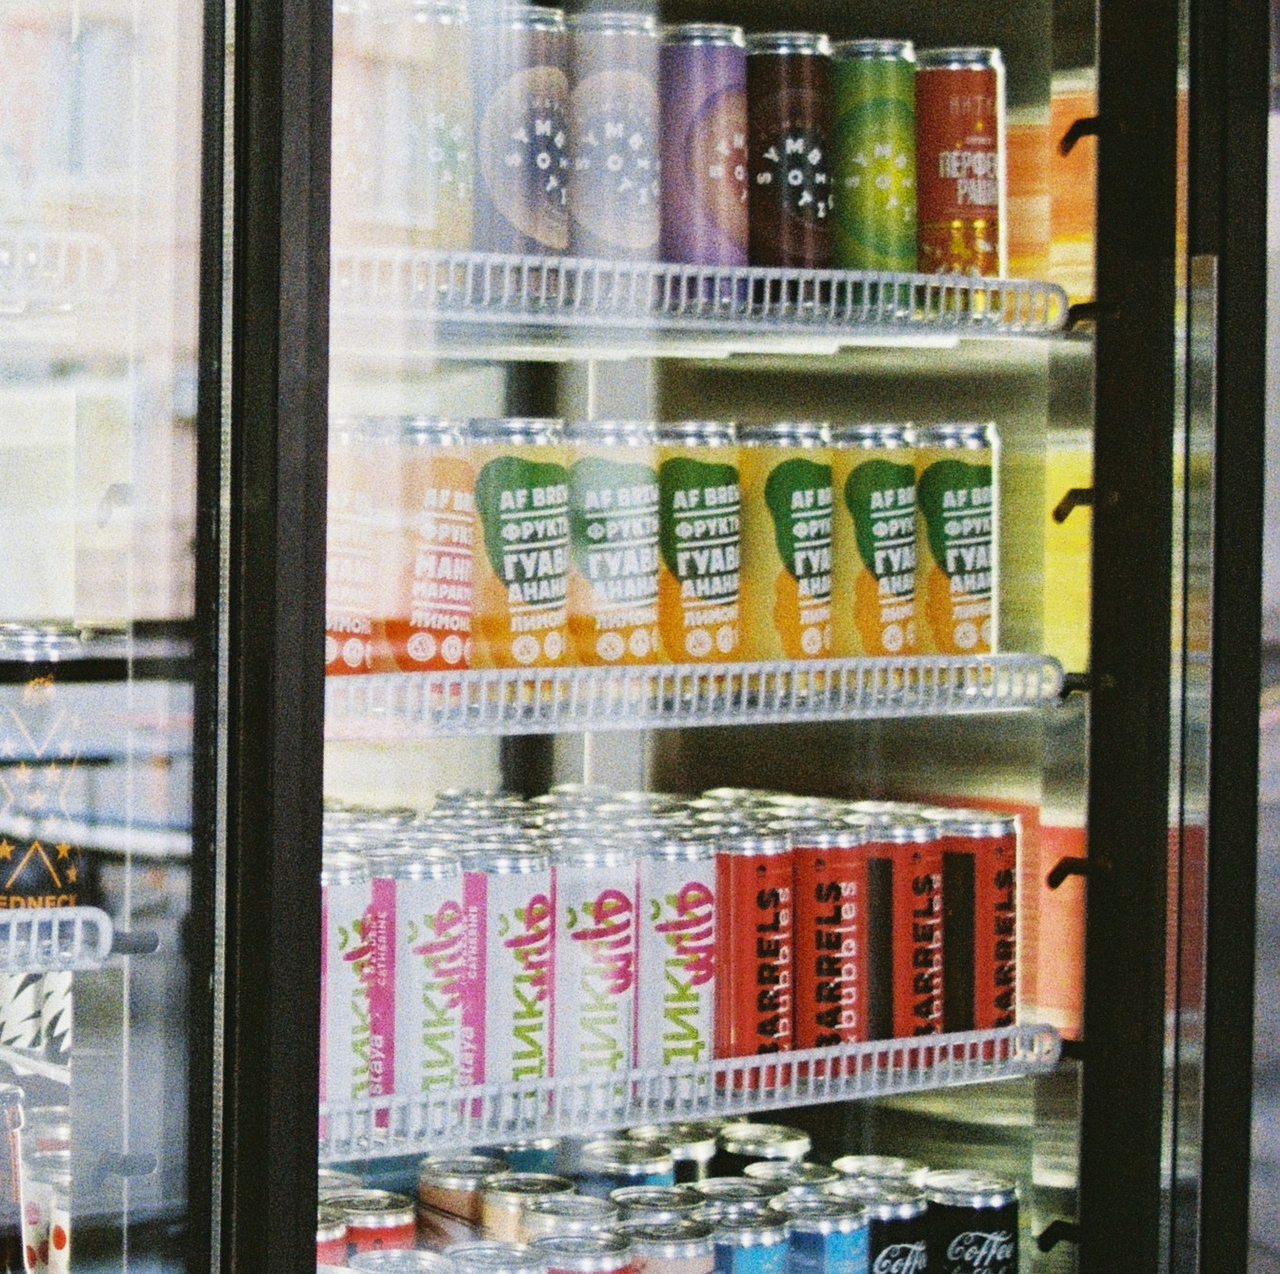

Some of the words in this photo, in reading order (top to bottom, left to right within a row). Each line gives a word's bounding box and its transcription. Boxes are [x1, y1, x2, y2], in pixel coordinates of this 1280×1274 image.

[500, 489, 528, 510] AF
[585, 489, 612, 509] AF
[674, 489, 700, 509] AF
[791, 489, 814, 509] AF
[871, 489, 895, 509] AF
[943, 489, 968, 508] AF
[769, 887, 789, 1038] bubbles
[830, 882, 857, 1028] bubbles
